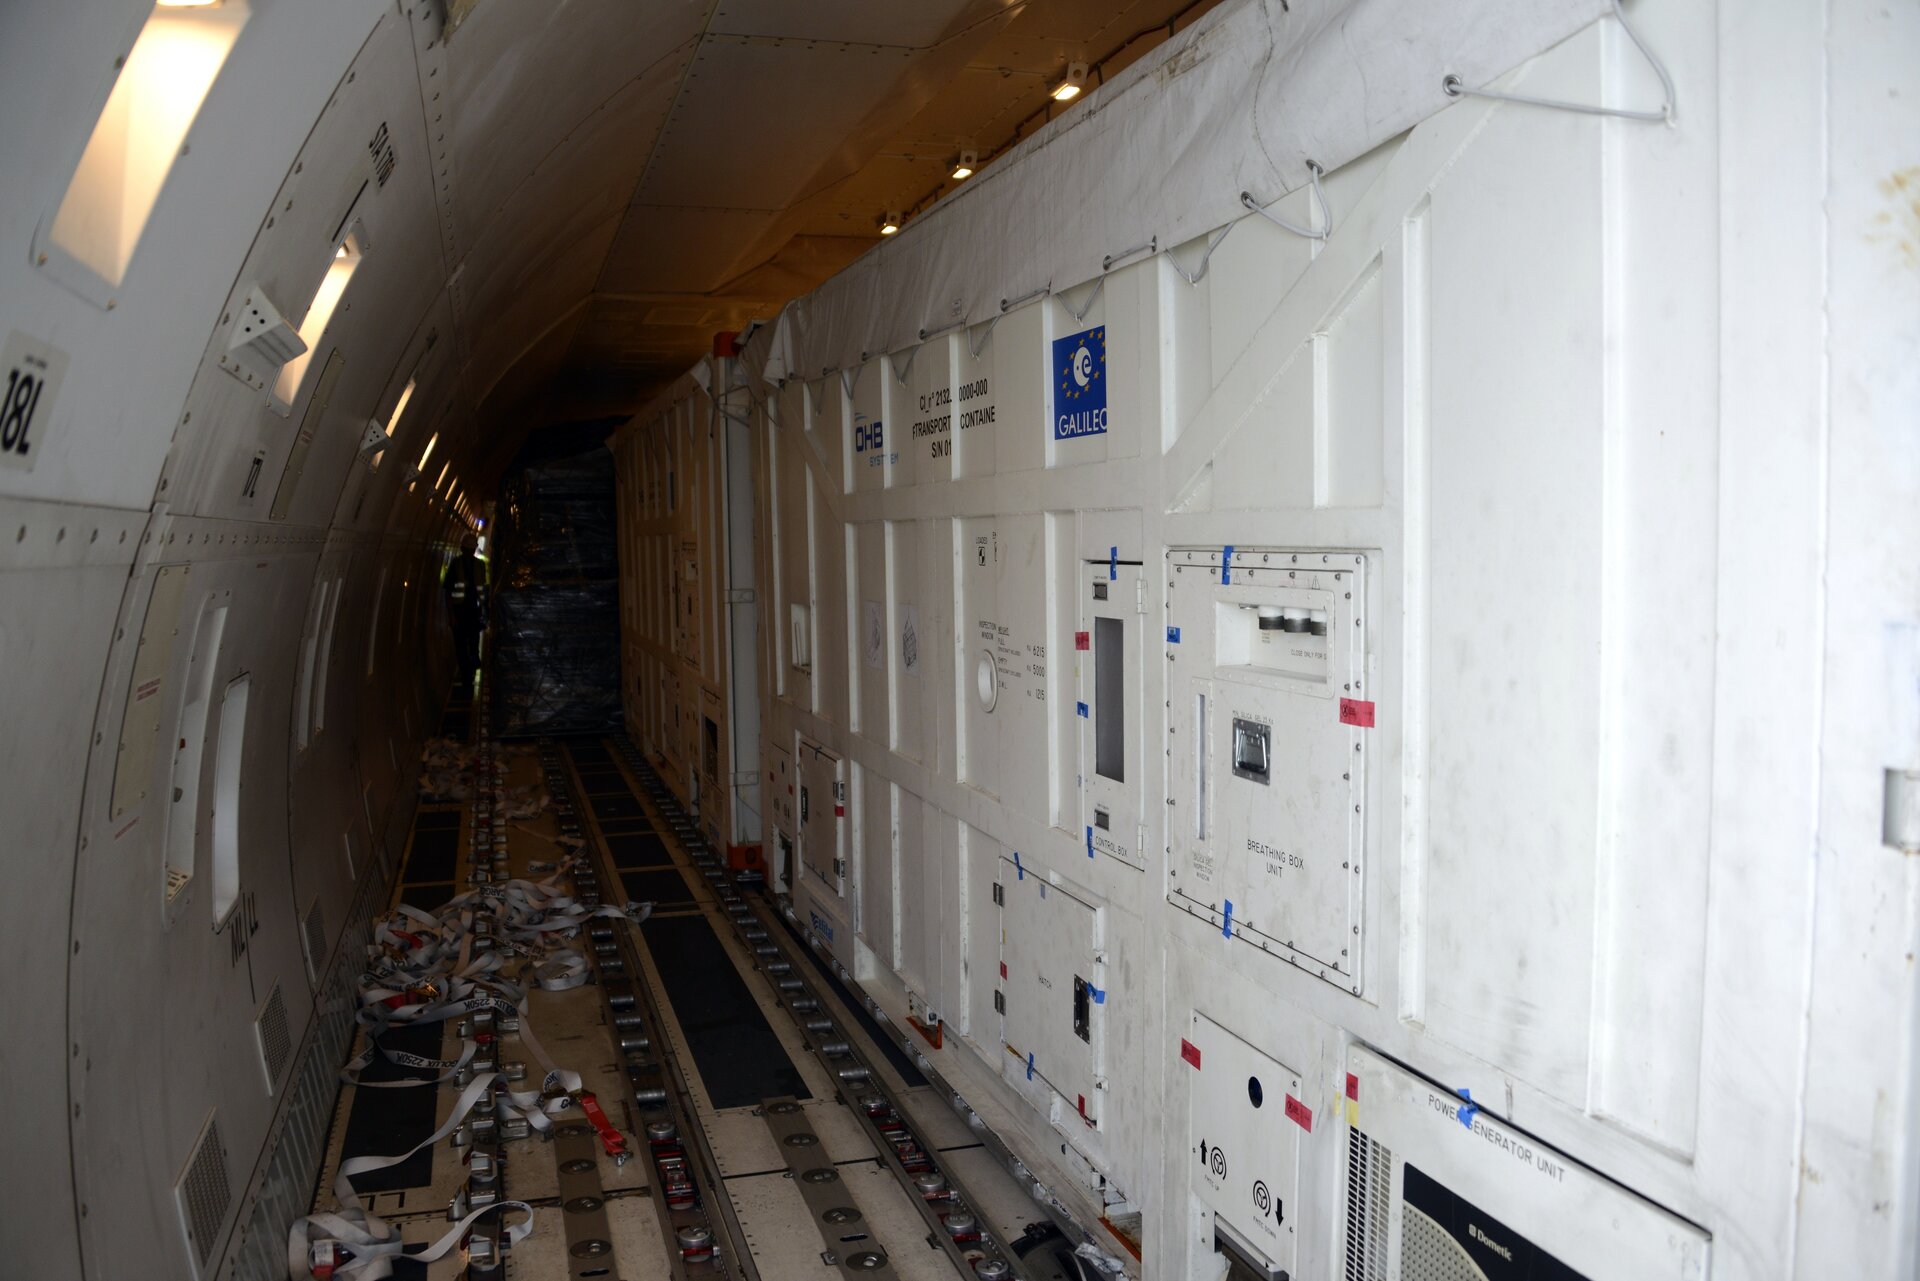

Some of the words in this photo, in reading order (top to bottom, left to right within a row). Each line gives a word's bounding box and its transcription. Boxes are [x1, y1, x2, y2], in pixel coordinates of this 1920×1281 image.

[856, 421, 883, 452] OHB
[1033, 645, 1045, 658] 6215
[1033, 664, 1045, 678] 5000
[1036, 689, 1045, 701] 1215
[1095, 835, 1117, 854] CONTROL
[1118, 846, 1128, 858] BOX
[1247, 839, 1286, 864] BREATHING
[1289, 854, 1304, 871] BOX
[1266, 862, 1282, 879] UNIT
[1039, 975, 1052, 990] HATCH
[464, 998, 490, 1011] 2250K
[1537, 1156, 1566, 1183] UNIT
[1477, 1228, 1512, 1262] Dometic
